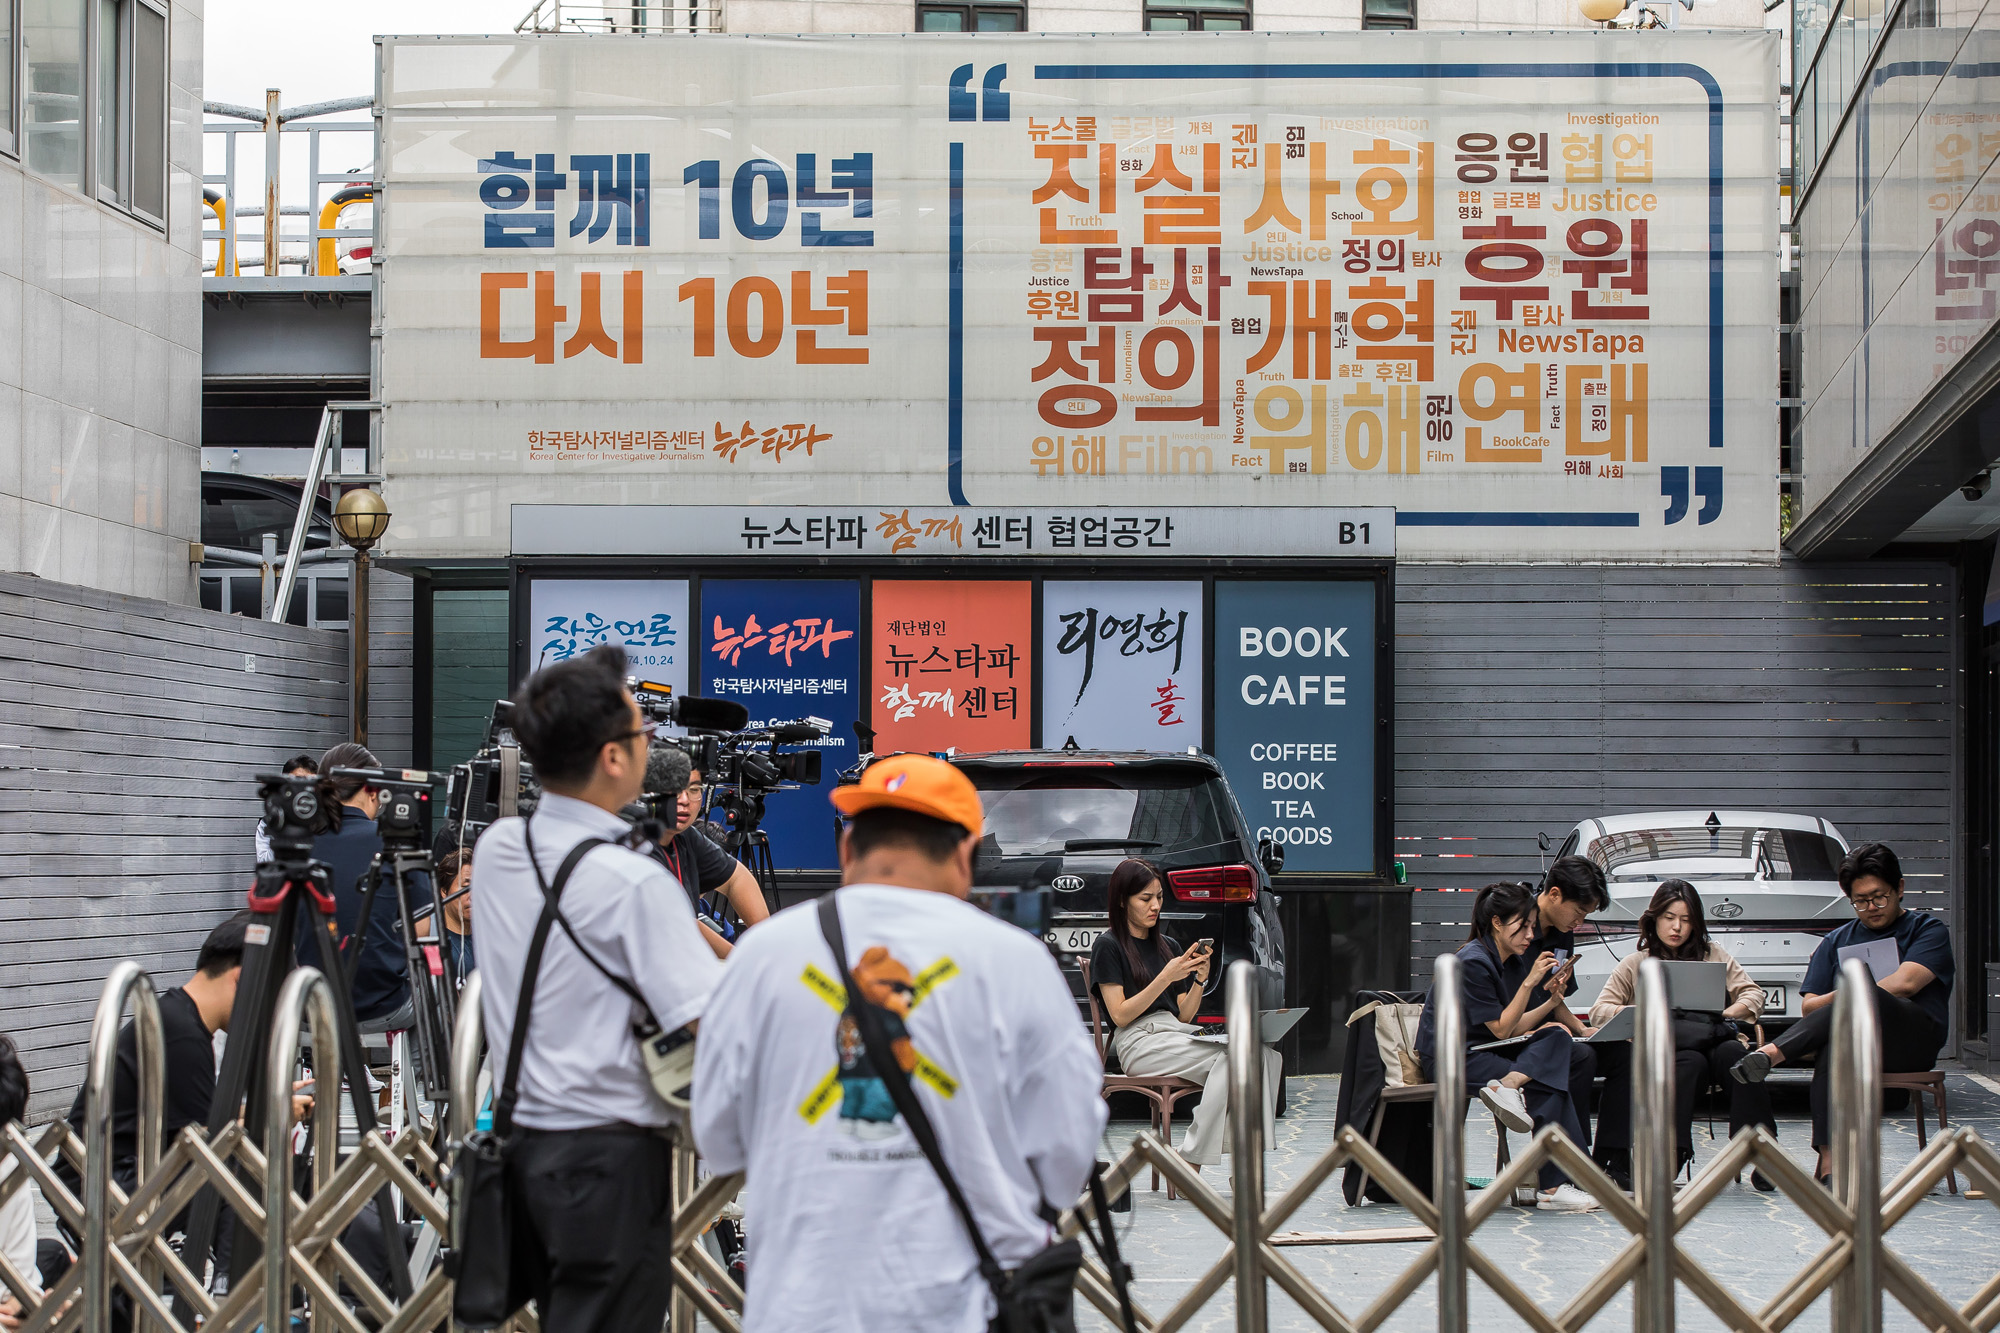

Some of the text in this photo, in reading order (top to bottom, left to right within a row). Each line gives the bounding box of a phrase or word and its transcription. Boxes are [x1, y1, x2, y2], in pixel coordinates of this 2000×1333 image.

[1027, 116, 1097, 142] 뉴스쿨
[1111, 116, 1175, 140] 글로벌
[1187, 121, 1214, 136] 개혁
[1318, 116, 1430, 131] Investigation
[1567, 112, 1660, 128] Investigation
[1179, 145, 1198, 156] 사회
[1231, 123, 1258, 170] 진실
[1286, 126, 1305, 159] 협업
[1120, 159, 1144, 172] 영화
[1454, 132, 1549, 184] 응원
[1561, 132, 1654, 184] 협업
[477, 151, 875, 248] 함께 10년
[1032, 142, 1222, 245] 진실
[1244, 139, 1435, 241] 사회
[1458, 191, 1481, 204] 협업
[1492, 191, 1541, 209] 글로벌
[1552, 187, 1659, 213] Justice
[1067, 215, 1103, 227] Truth
[1331, 210, 1364, 221] School
[1458, 206, 1483, 220] 영화
[1266, 231, 1287, 243] 연대
[1030, 248, 1074, 273] 응원
[1242, 241, 1332, 264] Justice
[1341, 239, 1405, 274] 정의
[1412, 252, 1443, 268] 탐사
[1191, 265, 1203, 285] 협업
[1250, 266, 1304, 278] NewsTapa
[1459, 215, 1650, 320] 후원
[1028, 275, 1070, 287] Justice
[1083, 246, 1232, 322] 탐사
[1026, 289, 1080, 321] 후원
[1600, 291, 1624, 304] 개혁
[480, 270, 870, 365] 다시 10년
[1154, 317, 1204, 326] Journalism
[1230, 317, 1262, 335] 협업
[1522, 305, 1565, 327] 탐사
[1246, 276, 1434, 382] 개혁
[1334, 310, 1348, 350] 뉴스쿨
[1450, 309, 1477, 356] 진실
[1498, 328, 1645, 360] NewsTapa
[1123, 330, 1133, 385] Journalism
[1031, 325, 1220, 429] 정의
[1258, 372, 1285, 381] Truth
[1338, 364, 1364, 378] 출판
[1375, 362, 1412, 383] 후원
[1546, 363, 1558, 399] Truth
[1122, 392, 1173, 404] NewsTapa
[1583, 382, 1608, 396] 출판
[1067, 401, 1086, 412] 연대
[1232, 378, 1246, 444] NewsTapa
[1458, 362, 1649, 463] 연대
[1551, 404, 1560, 430] Fact
[1250, 382, 1421, 475] 위해
[1426, 394, 1453, 442] 응원
[1592, 404, 1607, 432] 정의
[528, 430, 705, 451] 한국탐사저널리즘센터
[712, 420, 833, 464] 뉴스타파
[1172, 432, 1227, 442] Investigation
[1330, 397, 1340, 465] Investigation
[1493, 436, 1551, 447] BookCafe
[530, 452, 705, 462] Korea Center for Investigative Journalism
[1030, 434, 1106, 477] 위해
[1118, 434, 1214, 475] Film
[1231, 454, 1263, 467] Fact
[1426, 450, 1454, 462] Film
[1288, 461, 1308, 473] 협업
[1563, 460, 1592, 476] 위해
[1597, 464, 1624, 479] 사회
[740, 508, 1371, 554] 뉴스타파 함께 센터 협업공간 B1
[886, 620, 946, 637] 재단법인
[711, 613, 854, 668] 뉴스타파
[1240, 626, 1350, 658] BOOK
[627, 655, 674, 666] 74.10.24
[885, 643, 1020, 679] 뉴스타파
[1056, 607, 1189, 722] 리영희
[712, 677, 847, 695] 한국탐사저널리즘센터
[1241, 674, 1346, 706] CAFE
[880, 683, 1017, 723] 함께 센터
[1150, 678, 1186, 726] 홀
[1250, 743, 1337, 762] COFFEE
[1262, 772, 1325, 790] BOOK
[1271, 800, 1316, 818] TEA
[1256, 826, 1333, 845] GOODS
[1057, 878, 1080, 889] KIA
